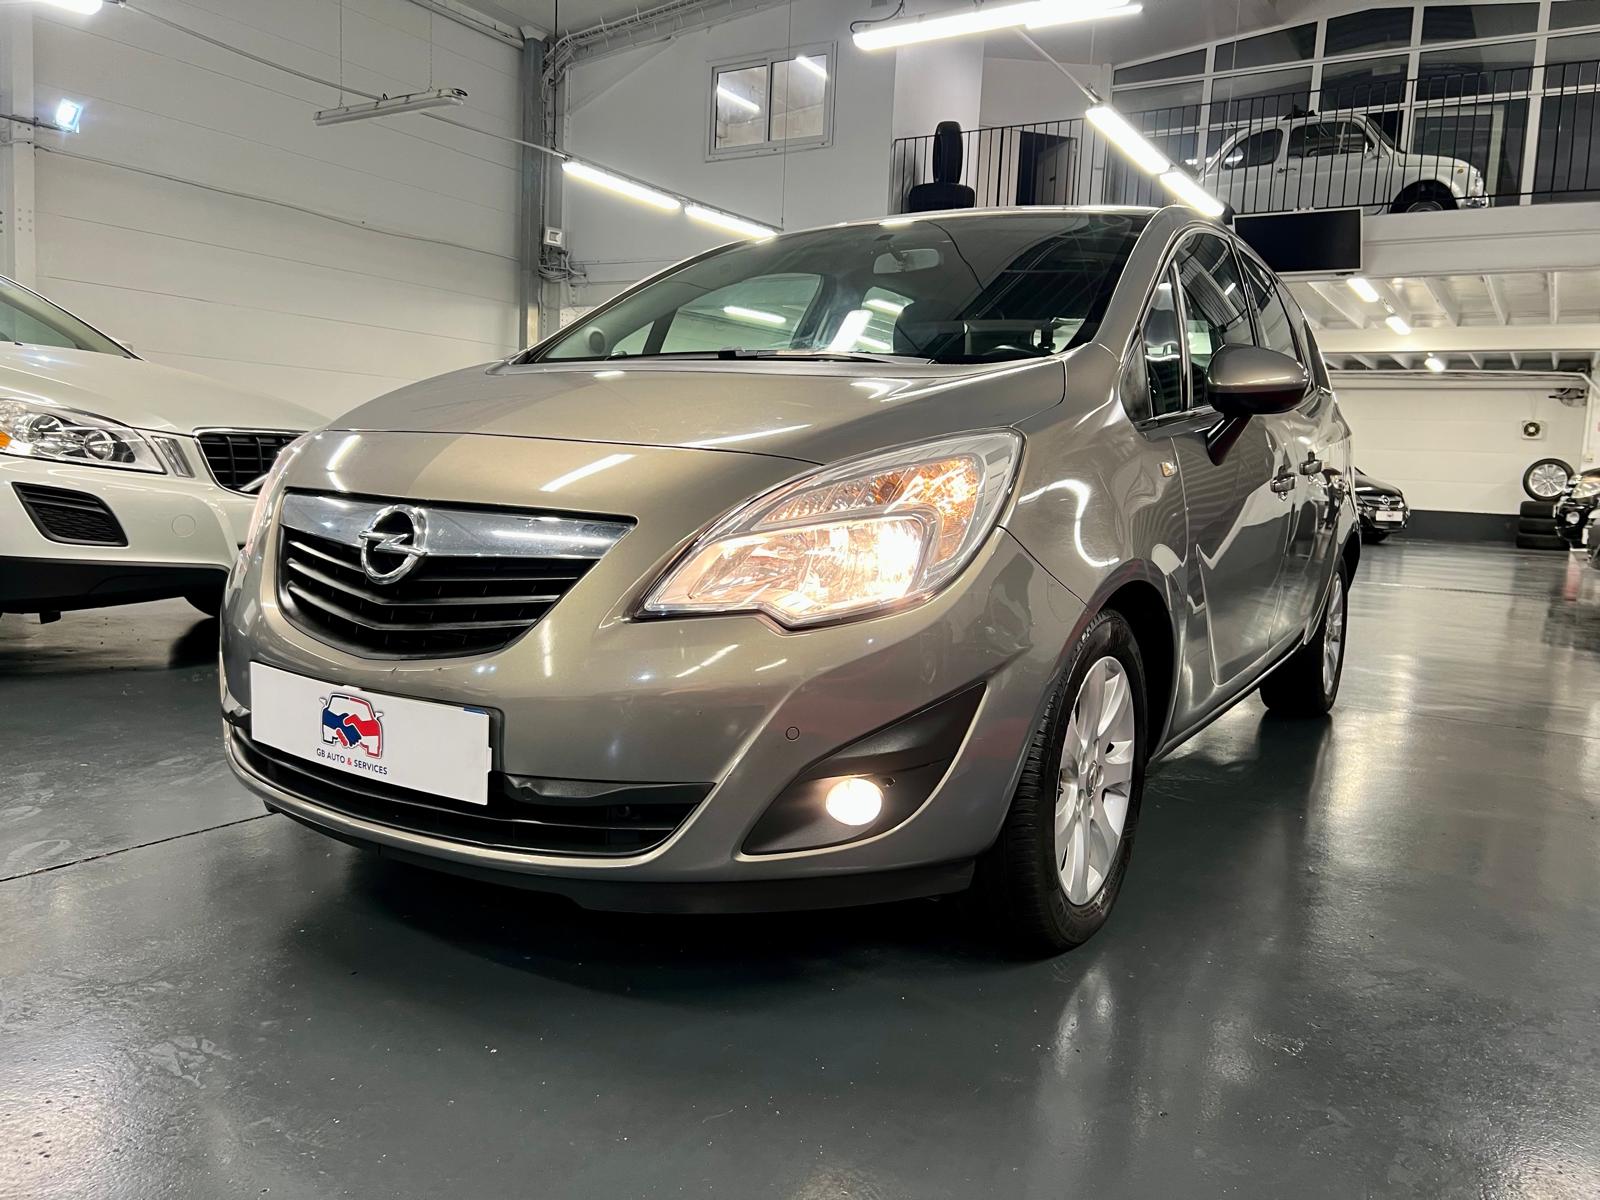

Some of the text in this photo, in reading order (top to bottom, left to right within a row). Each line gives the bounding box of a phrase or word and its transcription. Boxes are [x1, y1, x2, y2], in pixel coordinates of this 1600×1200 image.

[316, 747, 388, 775] GB AUTO & SERVICES
